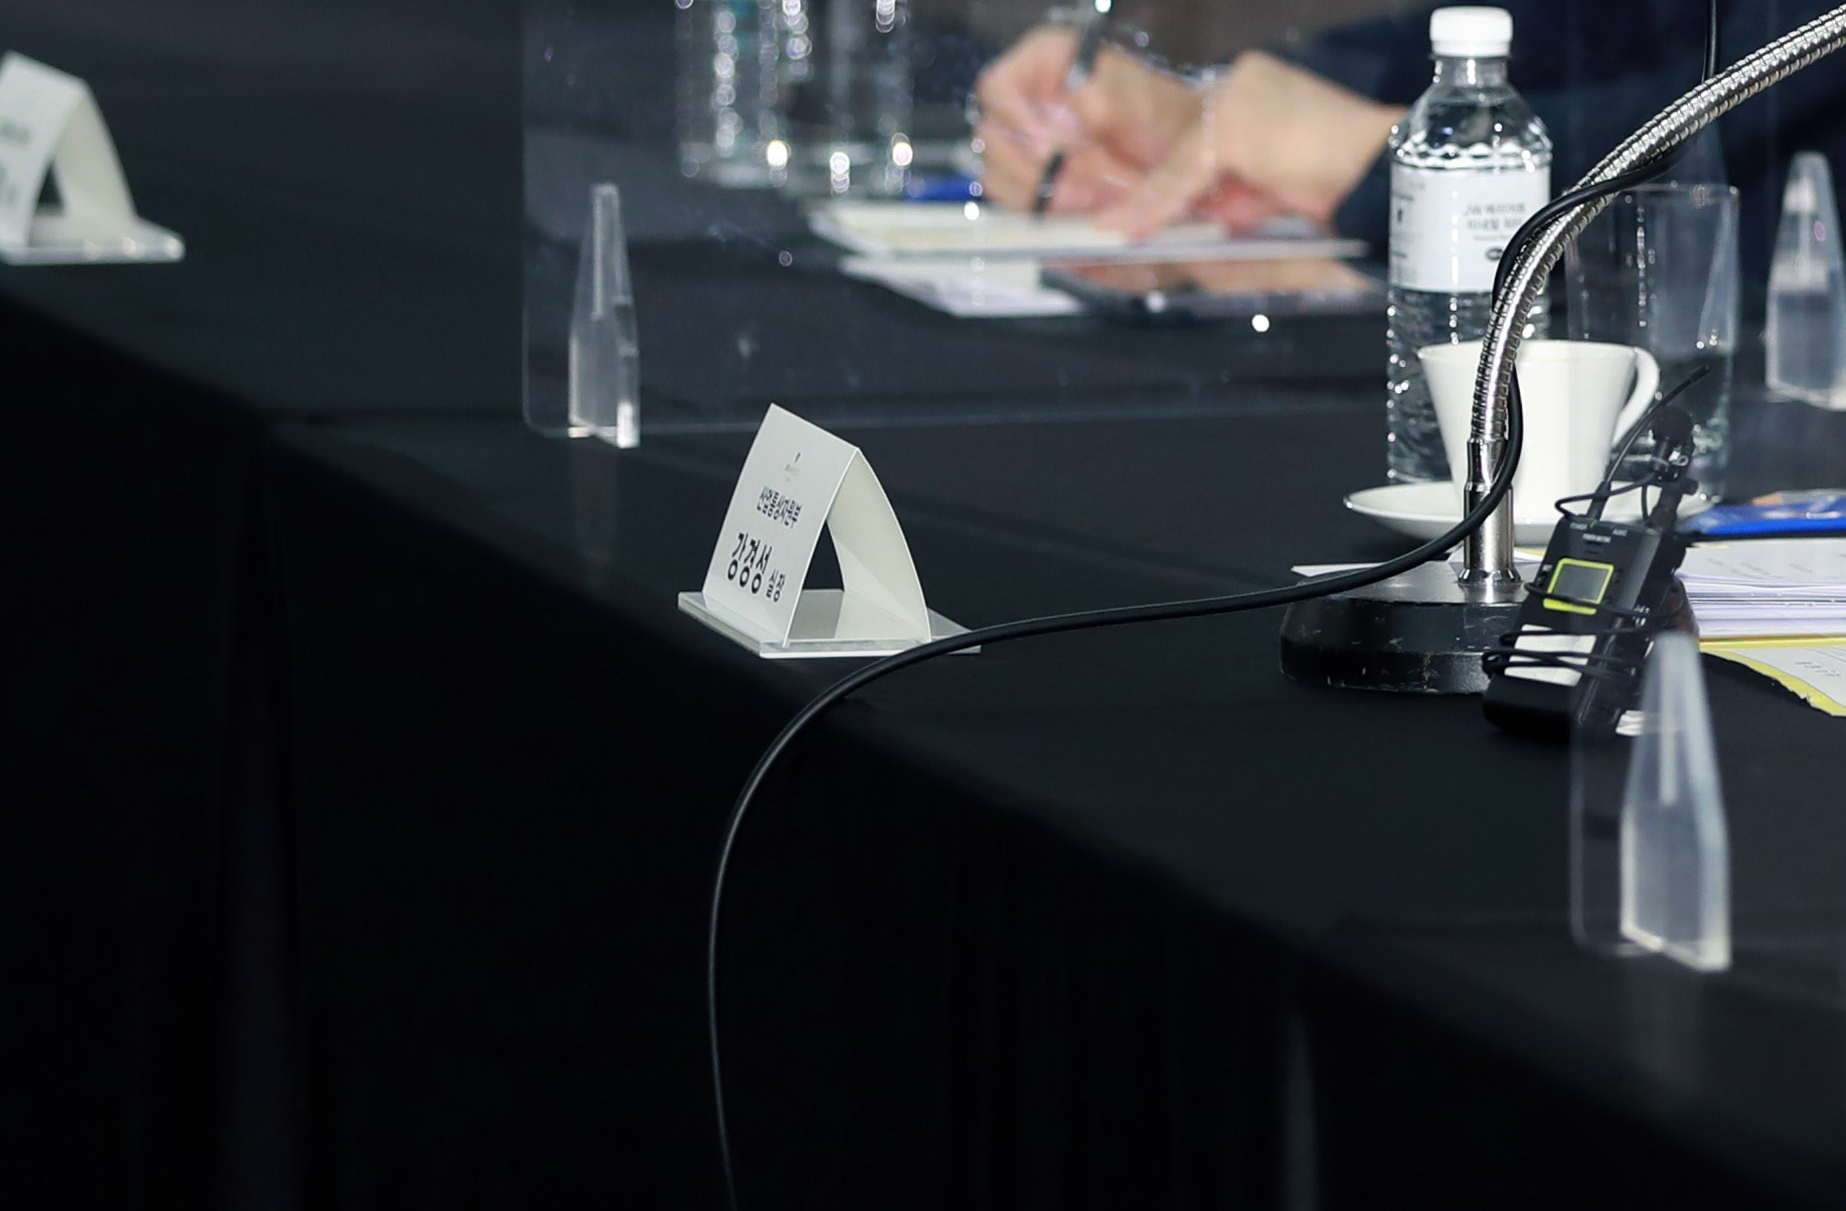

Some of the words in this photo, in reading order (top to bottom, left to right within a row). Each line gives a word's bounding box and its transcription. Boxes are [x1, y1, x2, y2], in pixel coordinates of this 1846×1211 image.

[757, 487, 802, 529] 산업통상자원부
[727, 532, 772, 595] 강경성
[765, 569, 786, 603] 실장
